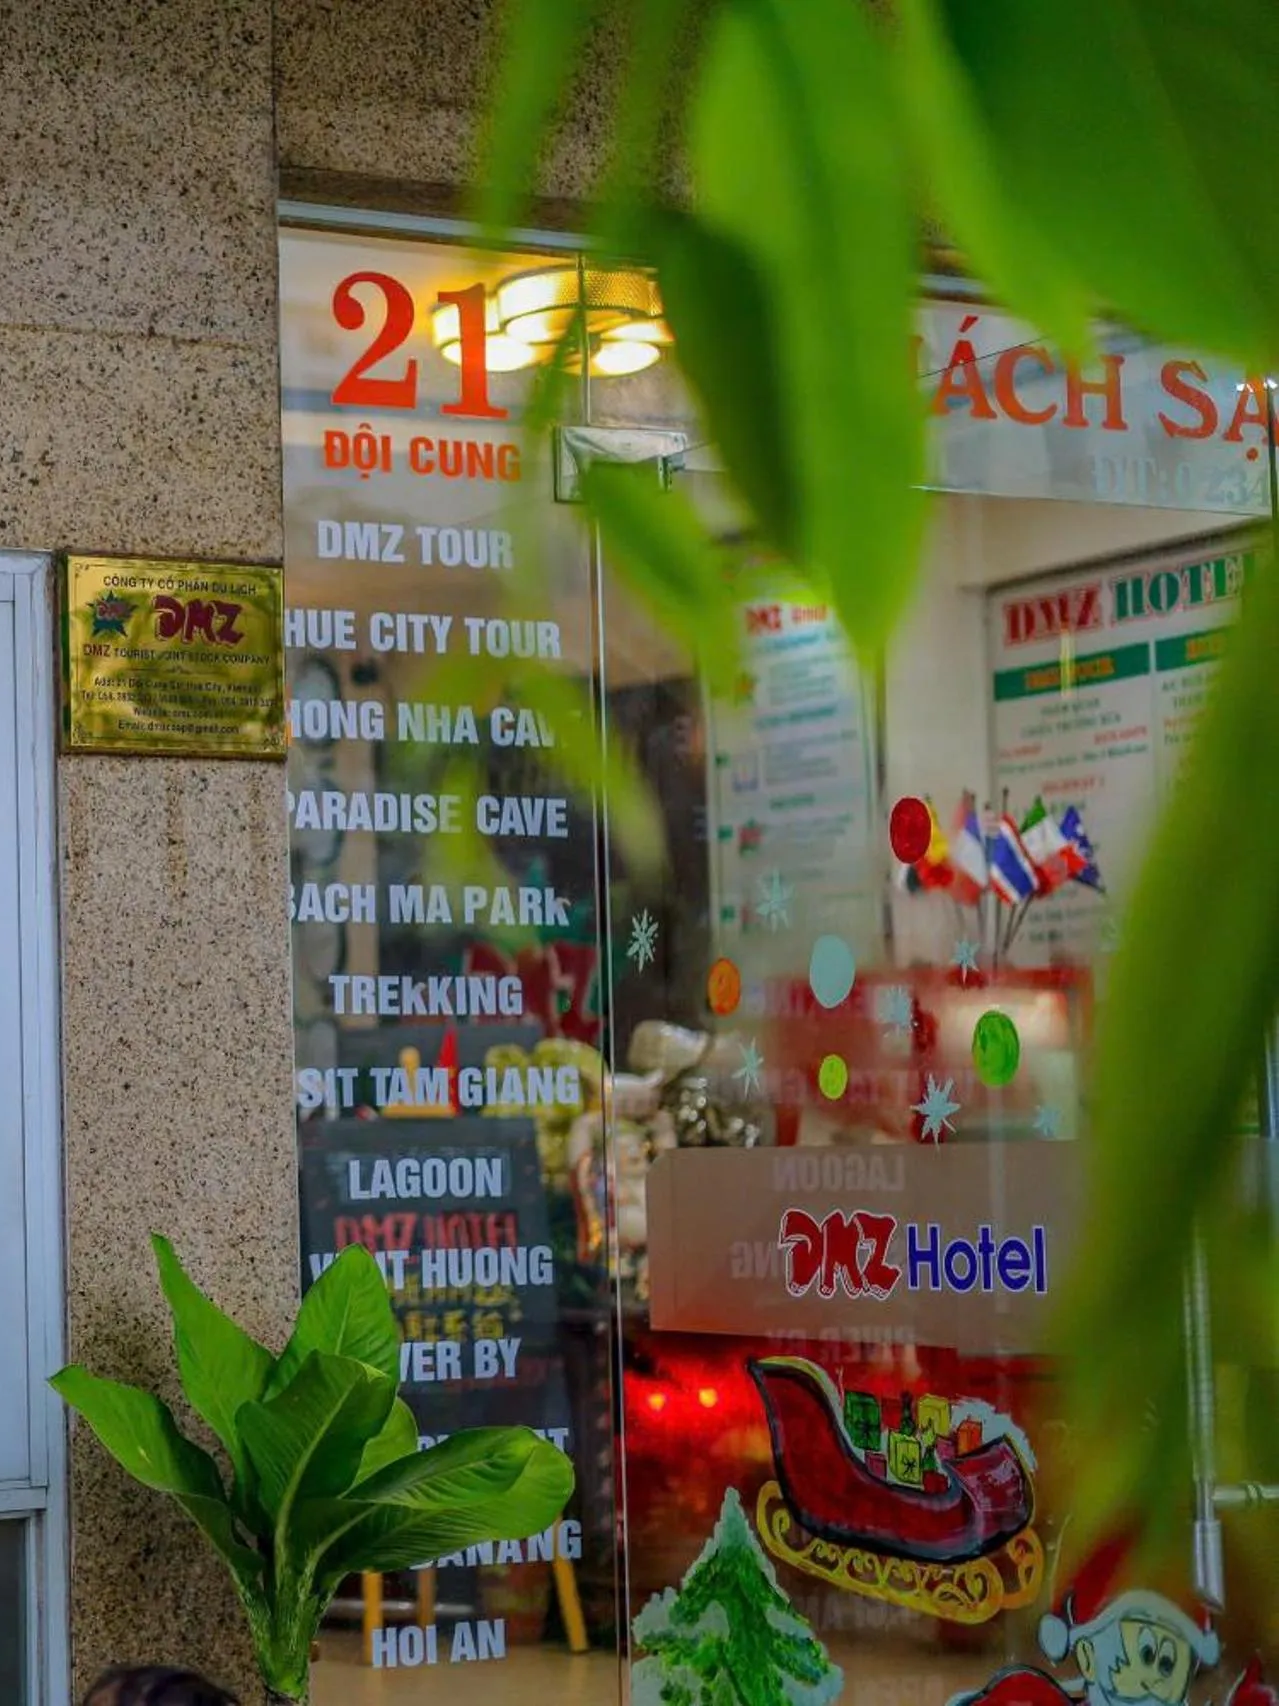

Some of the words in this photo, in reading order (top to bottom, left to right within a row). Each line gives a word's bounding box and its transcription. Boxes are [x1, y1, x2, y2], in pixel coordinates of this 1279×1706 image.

[332, 271, 509, 420] 21
[908, 315, 1129, 430] ÁCH
[324, 423, 392, 480] ĐỘI
[409, 436, 521, 482] CUNG
[317, 520, 405, 563] DMZ
[415, 526, 514, 569] TOUR
[103, 575, 137, 588] CÔNG
[139, 578, 154, 589] TY
[153, 594, 244, 646] DMZ
[284, 608, 357, 651] HUE
[369, 612, 453, 654] CITY
[464, 616, 563, 660] TOUR
[83, 644, 112, 658] DMZ
[114, 648, 156, 661] TOURIST
[398, 703, 479, 745] NHA
[476, 796, 568, 839] CAVE
[388, 884, 452, 925] MA
[463, 885, 571, 927] PARK
[328, 974, 524, 1016] TREKKING
[370, 1067, 451, 1108] TAM
[458, 1066, 580, 1108] GIANG
[348, 1157, 504, 1200] LAGOON
[421, 1245, 554, 1289] HUONG
[778, 1208, 903, 1300] DMZ
[907, 1223, 1048, 1294] Hotel
[474, 1337, 521, 1379] BY
[371, 1622, 438, 1668] HOI
[450, 1618, 506, 1663] AN
